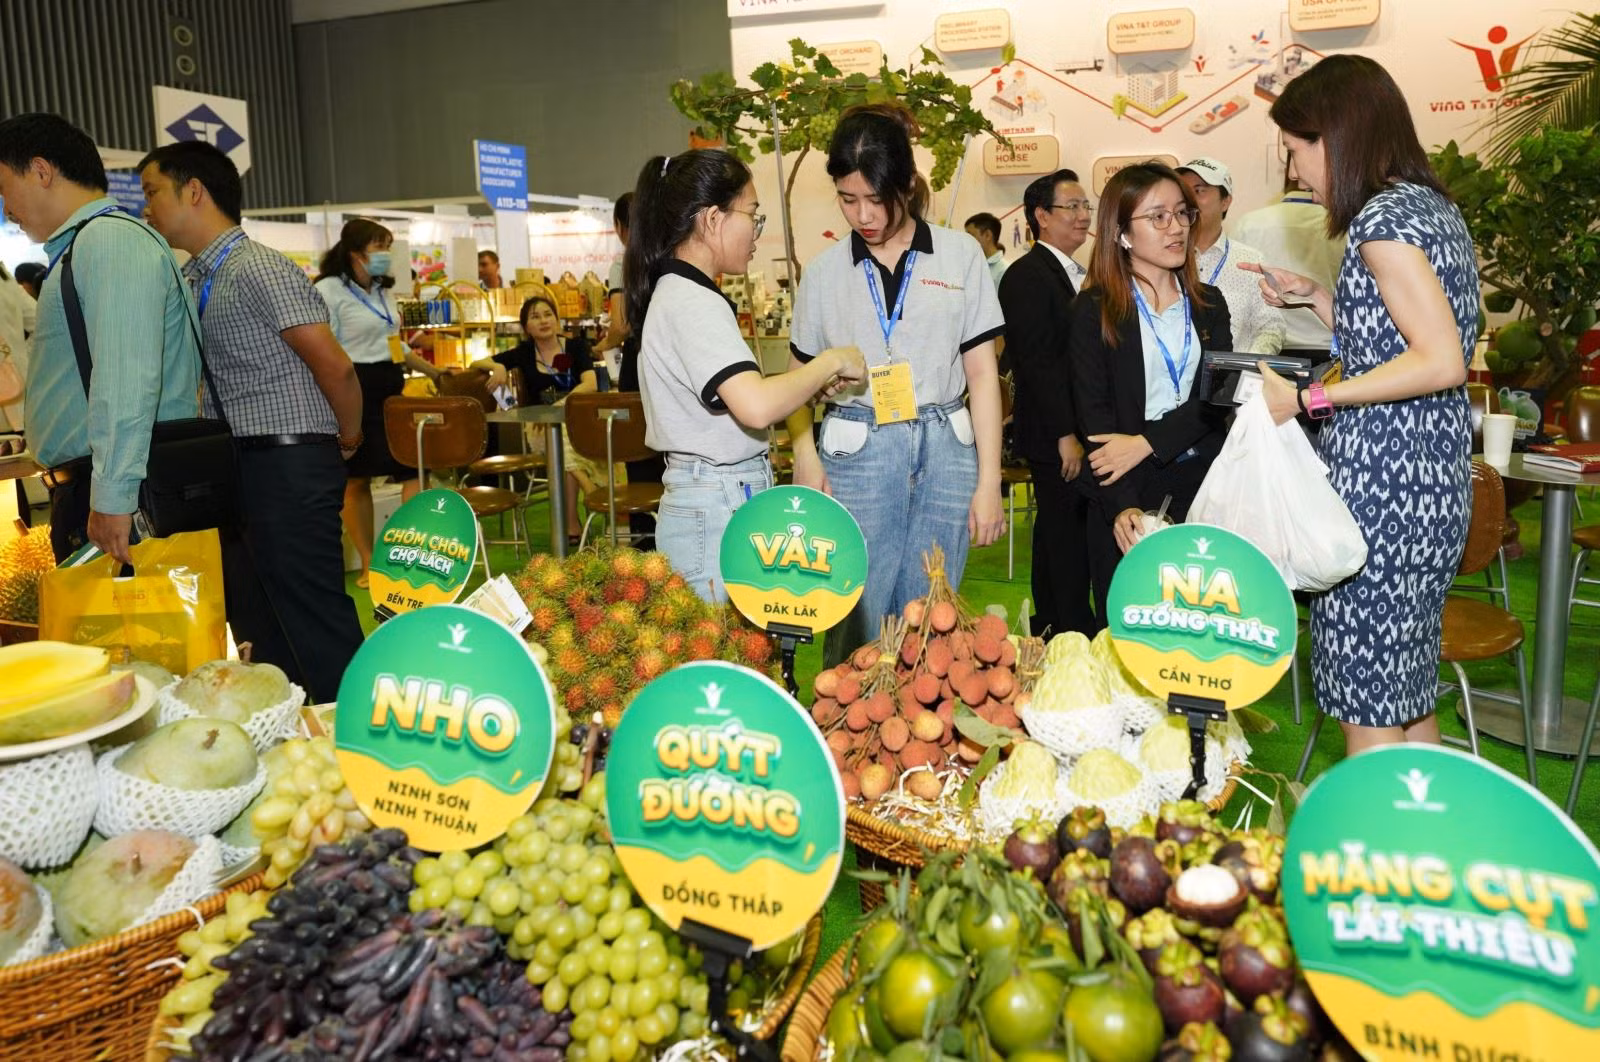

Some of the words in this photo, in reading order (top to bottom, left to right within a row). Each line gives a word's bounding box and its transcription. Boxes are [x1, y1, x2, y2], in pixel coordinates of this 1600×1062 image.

[1116, 23, 1134, 31] VINA
[1137, 21, 1150, 29] T&T
[1152, 19, 1181, 28] GROUP
[1471, 99, 1496, 110] T&T
[996, 143, 1038, 152] PAKING
[383, 528, 427, 546] CHÔM
[429, 535, 471, 562] CHÔM
[389, 546, 419, 566] CHỢ
[418, 550, 454, 575] LÁCH
[750, 523, 836, 575] VẢI
[1160, 563, 1242, 616] NA
[1122, 602, 1209, 632] GIỐNG
[1212, 615, 1279, 649] THÁI
[1197, 674, 1232, 690] THƠ
[370, 673, 520, 754] NHO
[655, 719, 781, 777] QUÝT
[373, 796, 417, 820] NINH
[424, 809, 478, 835] THUẬN
[388, 780, 431, 803] NINH
[437, 790, 472, 812] SƠN
[639, 770, 801, 838] ĐƯỜNG
[729, 892, 783, 917] THÁP
[1300, 840, 1454, 902] MĂNG
[1465, 861, 1596, 930] CỤT
[1329, 894, 1406, 942] LÁI
[1414, 905, 1577, 977] THIÊU
